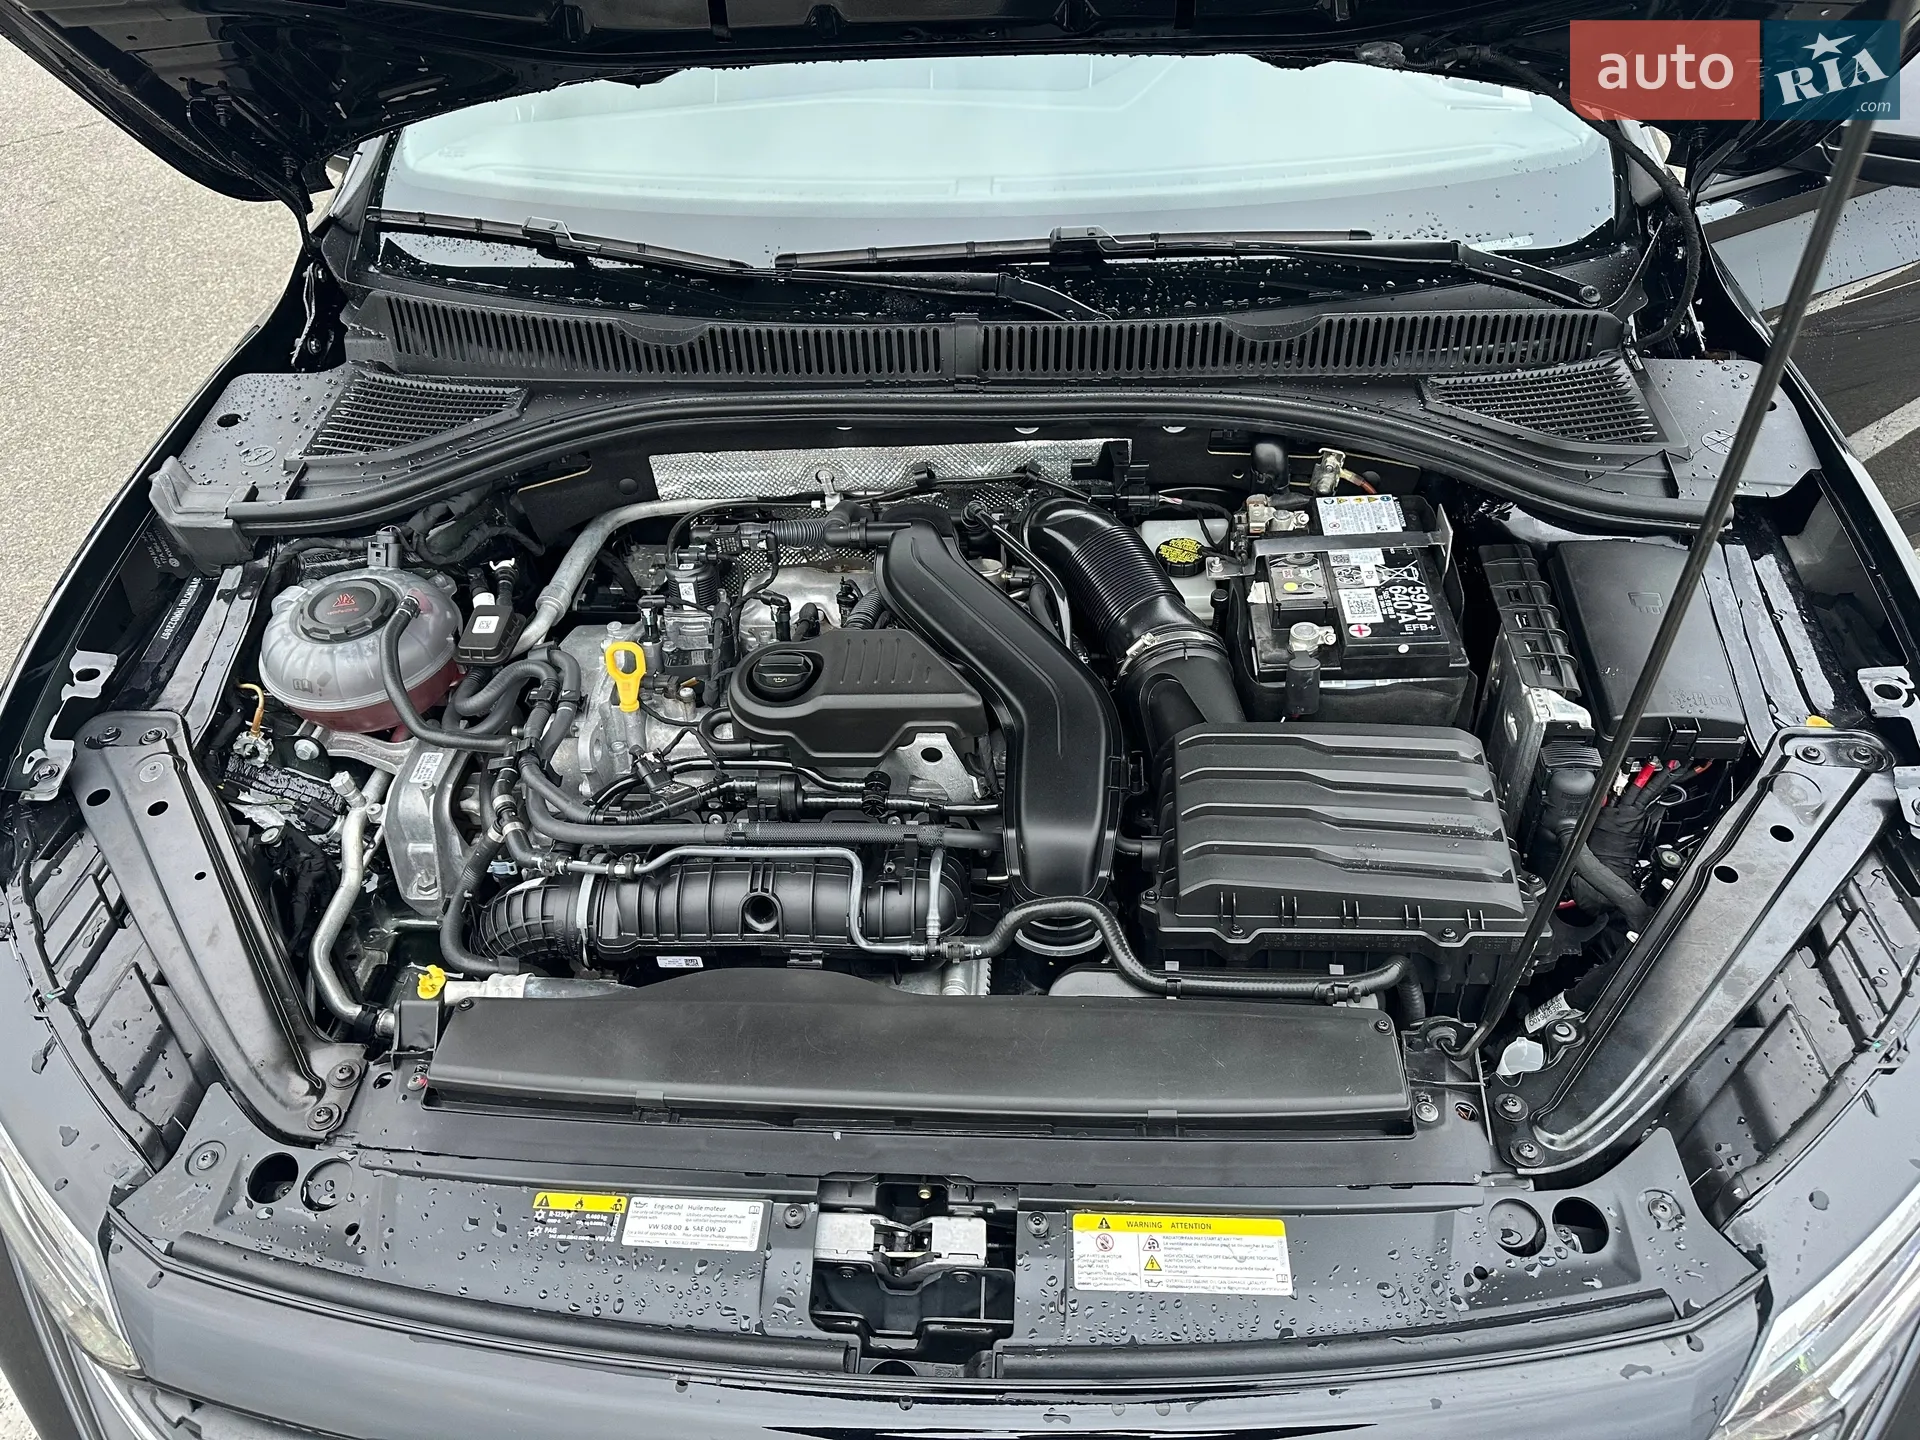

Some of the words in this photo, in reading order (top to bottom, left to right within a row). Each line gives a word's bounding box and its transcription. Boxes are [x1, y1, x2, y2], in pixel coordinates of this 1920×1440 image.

[1364, 570, 1374, 580] Pb
[1388, 586, 1412, 610] 640
[1408, 586, 1436, 621] 59Ah
[1396, 612, 1418, 624] A
[1404, 624, 1436, 632] EFB+
[1126, 1220, 1162, 1229] WARNING
[1170, 1222, 1212, 1230] ATTENTION
